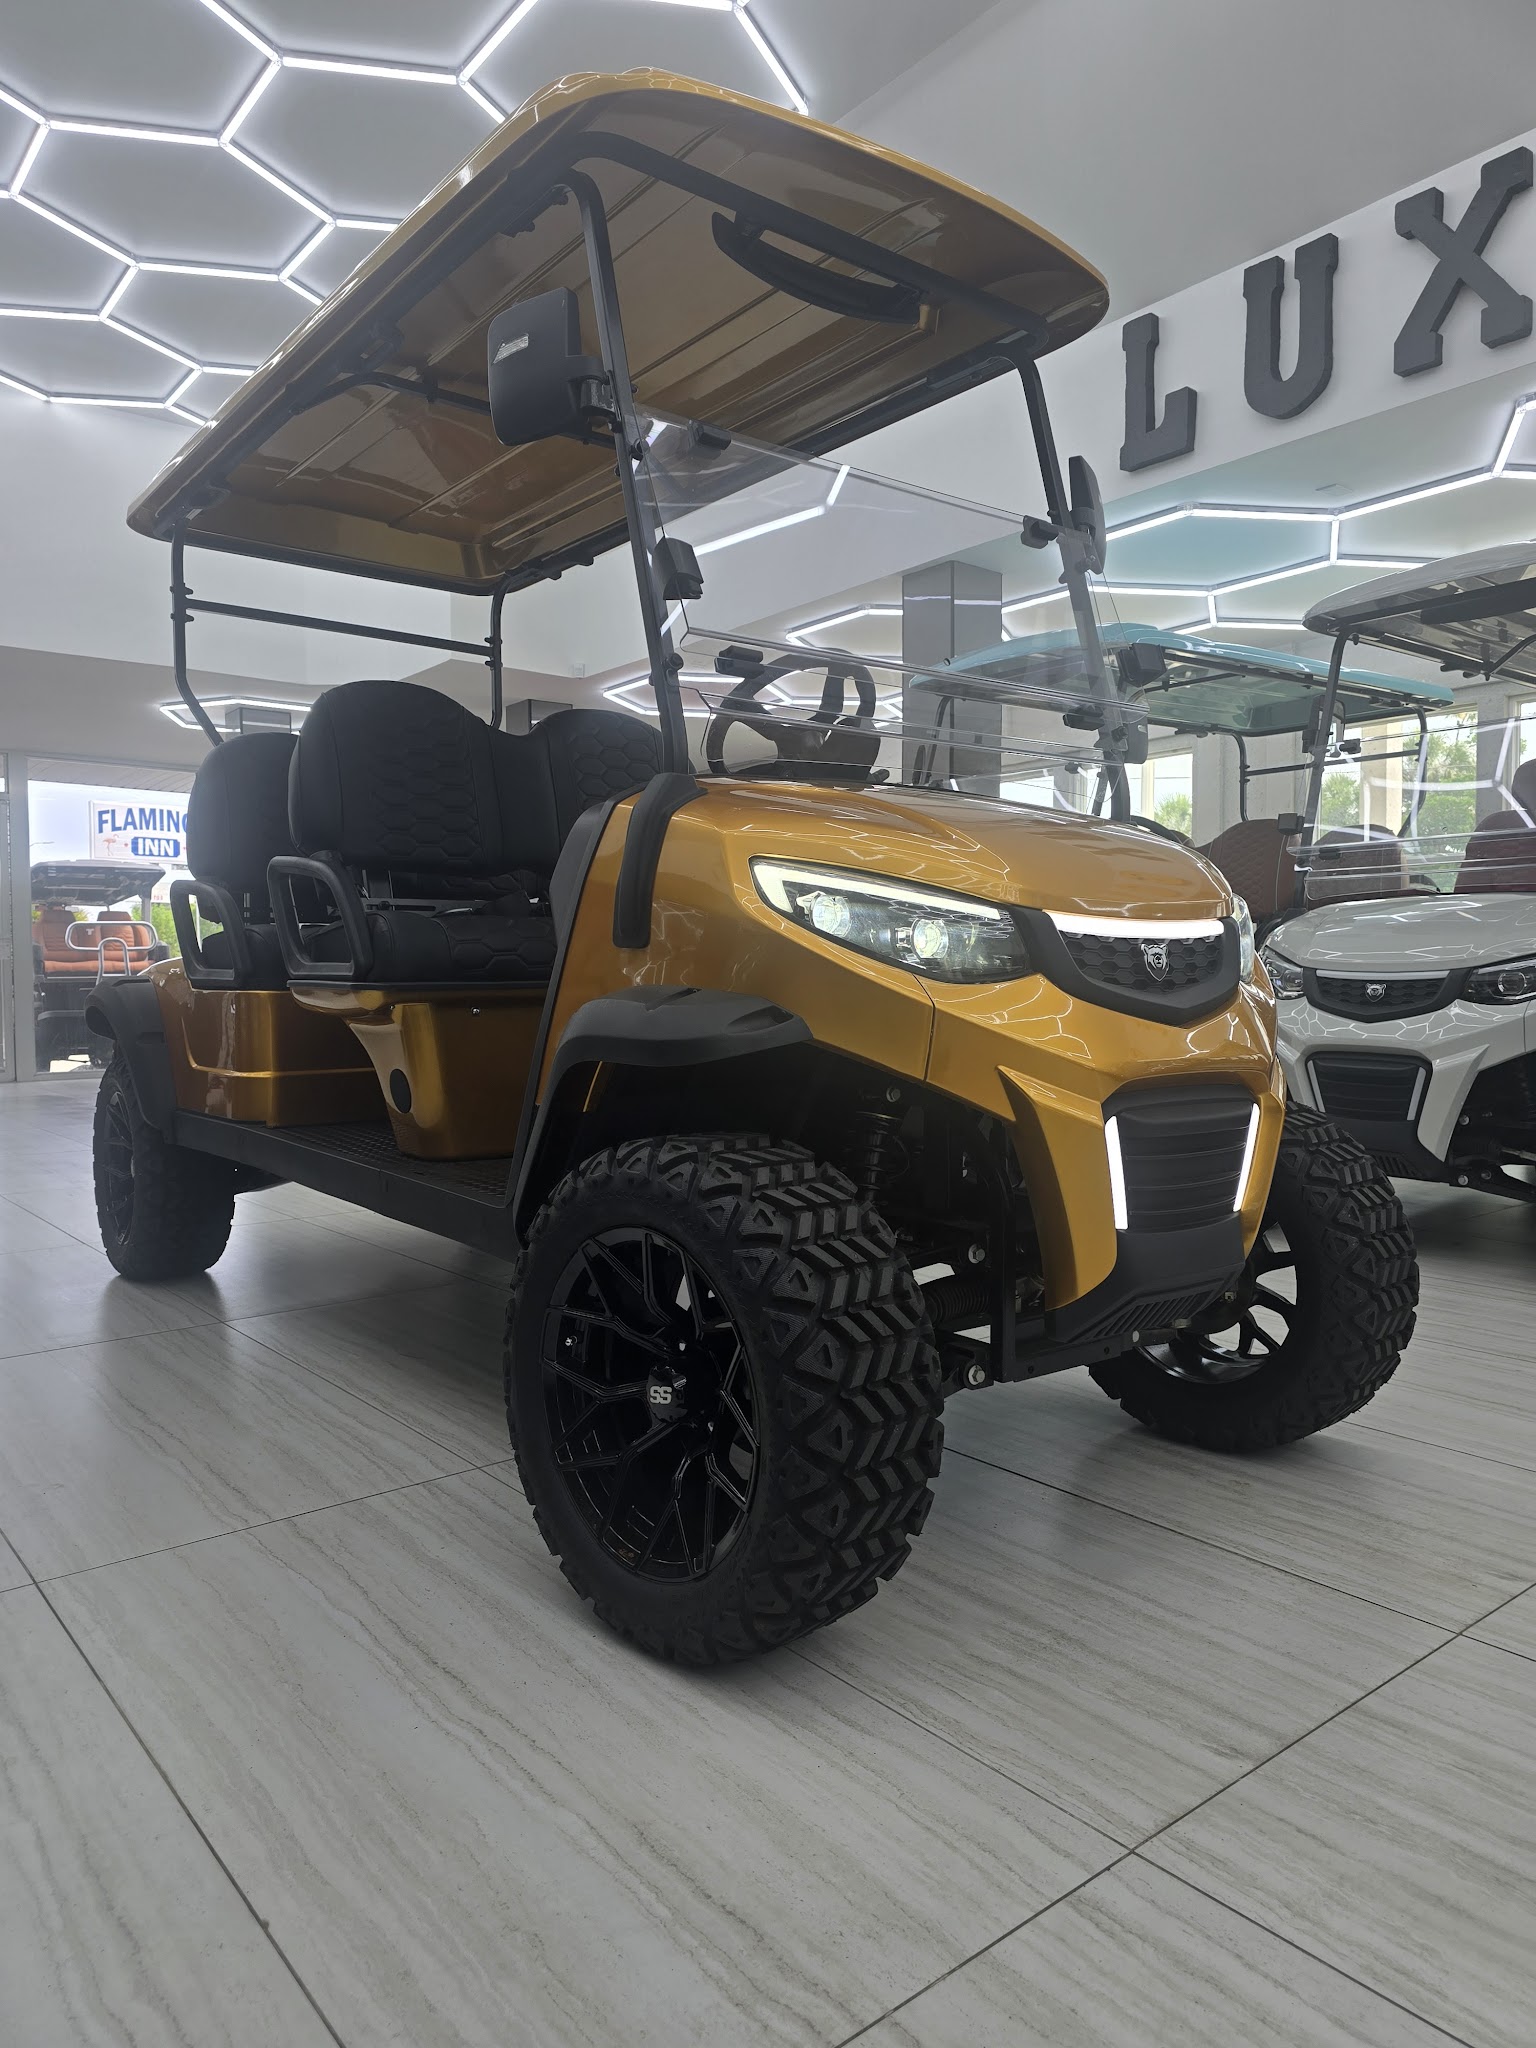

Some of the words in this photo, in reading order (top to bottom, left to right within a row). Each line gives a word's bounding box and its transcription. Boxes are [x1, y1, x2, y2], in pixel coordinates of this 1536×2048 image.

[1119, 145, 1534, 473] LUX
[137, 838, 174, 856] INN
[649, 1386, 672, 1405] SS
